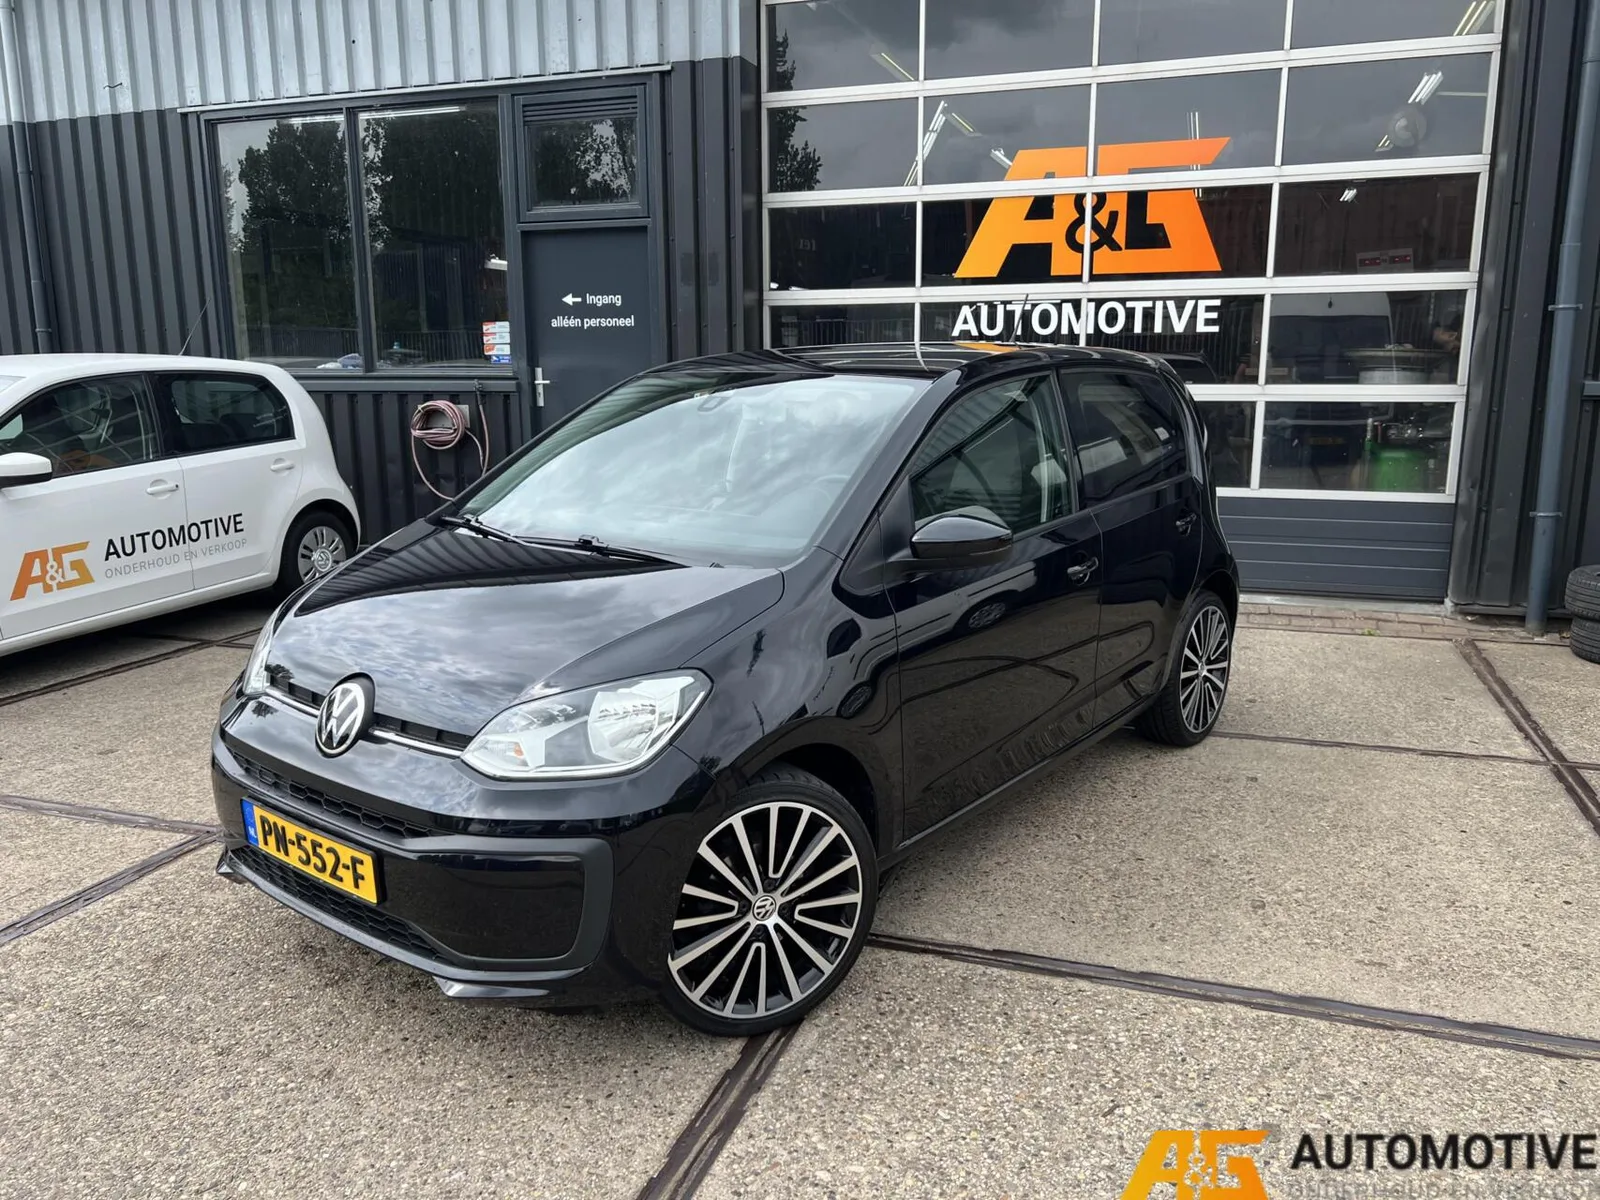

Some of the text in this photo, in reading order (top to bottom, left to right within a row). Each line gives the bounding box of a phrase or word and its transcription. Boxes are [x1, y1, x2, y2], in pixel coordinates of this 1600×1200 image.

[954, 137, 1230, 278] A&G
[586, 293, 622, 306] Ingang
[951, 299, 1221, 337] AUTOMOTIVE
[551, 315, 634, 329] alléén personeel
[10, 513, 244, 600] A&G AUTOMOTIVE
[104, 538, 247, 579] ONDERHOUD EN VERKOOP
[259, 814, 366, 890] PN-552-F
